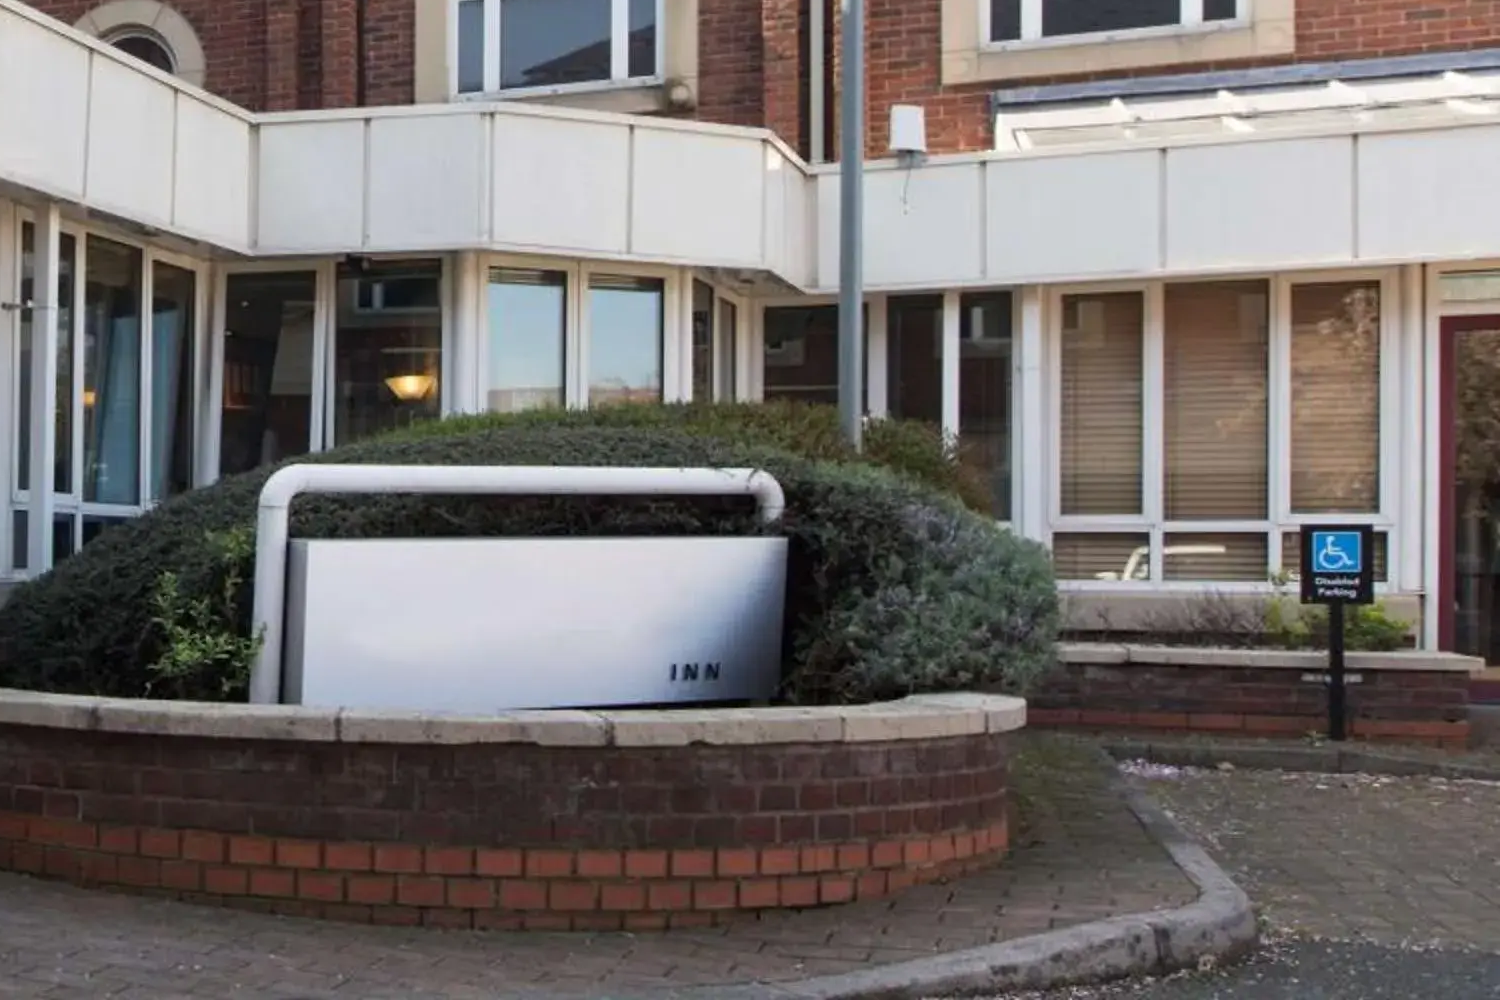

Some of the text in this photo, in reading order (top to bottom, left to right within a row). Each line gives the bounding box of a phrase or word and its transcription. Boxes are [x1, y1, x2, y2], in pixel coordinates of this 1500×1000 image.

[1315, 576, 1360, 585] Disabled
[1318, 588, 1357, 599] Parking
[670, 663, 721, 681] INN
